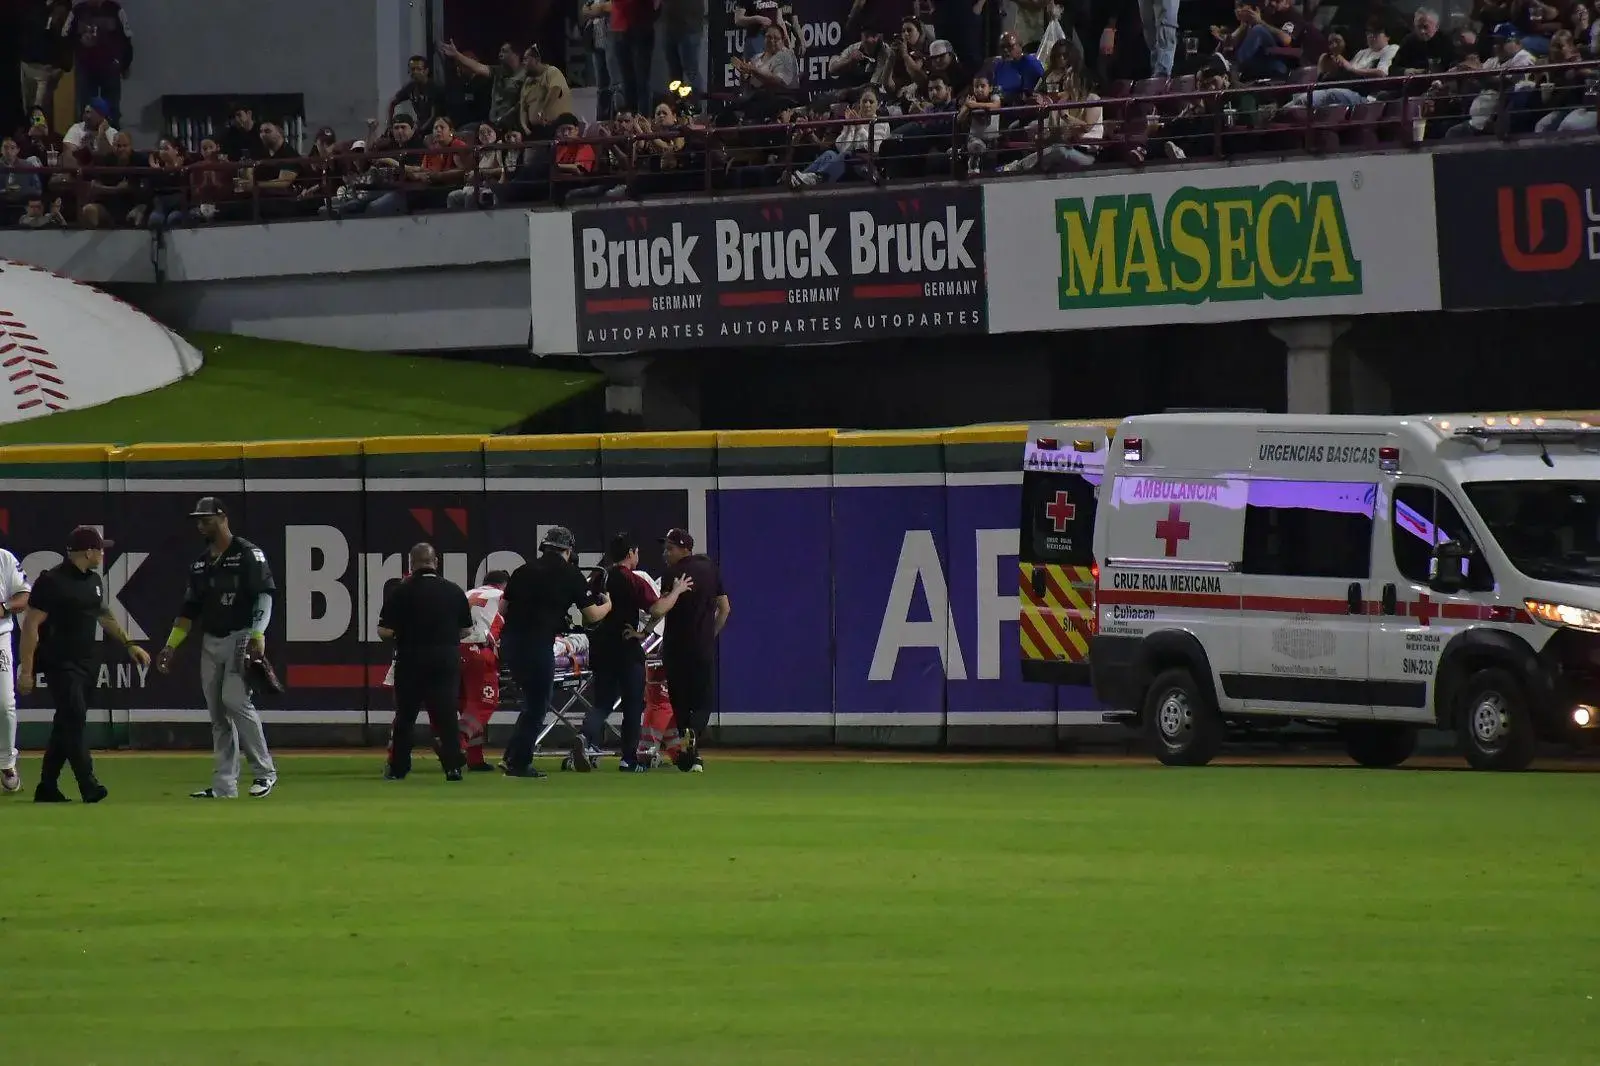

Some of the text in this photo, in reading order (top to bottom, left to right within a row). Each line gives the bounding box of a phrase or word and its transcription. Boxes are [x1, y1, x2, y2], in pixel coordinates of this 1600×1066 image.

[724, 30, 747, 53] TU
[1057, 185, 1360, 306] MASECA
[652, 279, 978, 311] GERMANY GERMANY GERMANY
[587, 311, 981, 342] AUTOPARTES AUTOPARTES AUTOPARTES
[1258, 445, 1377, 464] URGENCIAS BASICAS
[1133, 480, 1218, 500] AMBULANCIA
[1113, 572, 1222, 593] CRUZ ROJA MEXICANA
[220, 592, 237, 606] 47
[1113, 604, 1155, 620] Culiacan
[1402, 658, 1433, 675] SIN-233
